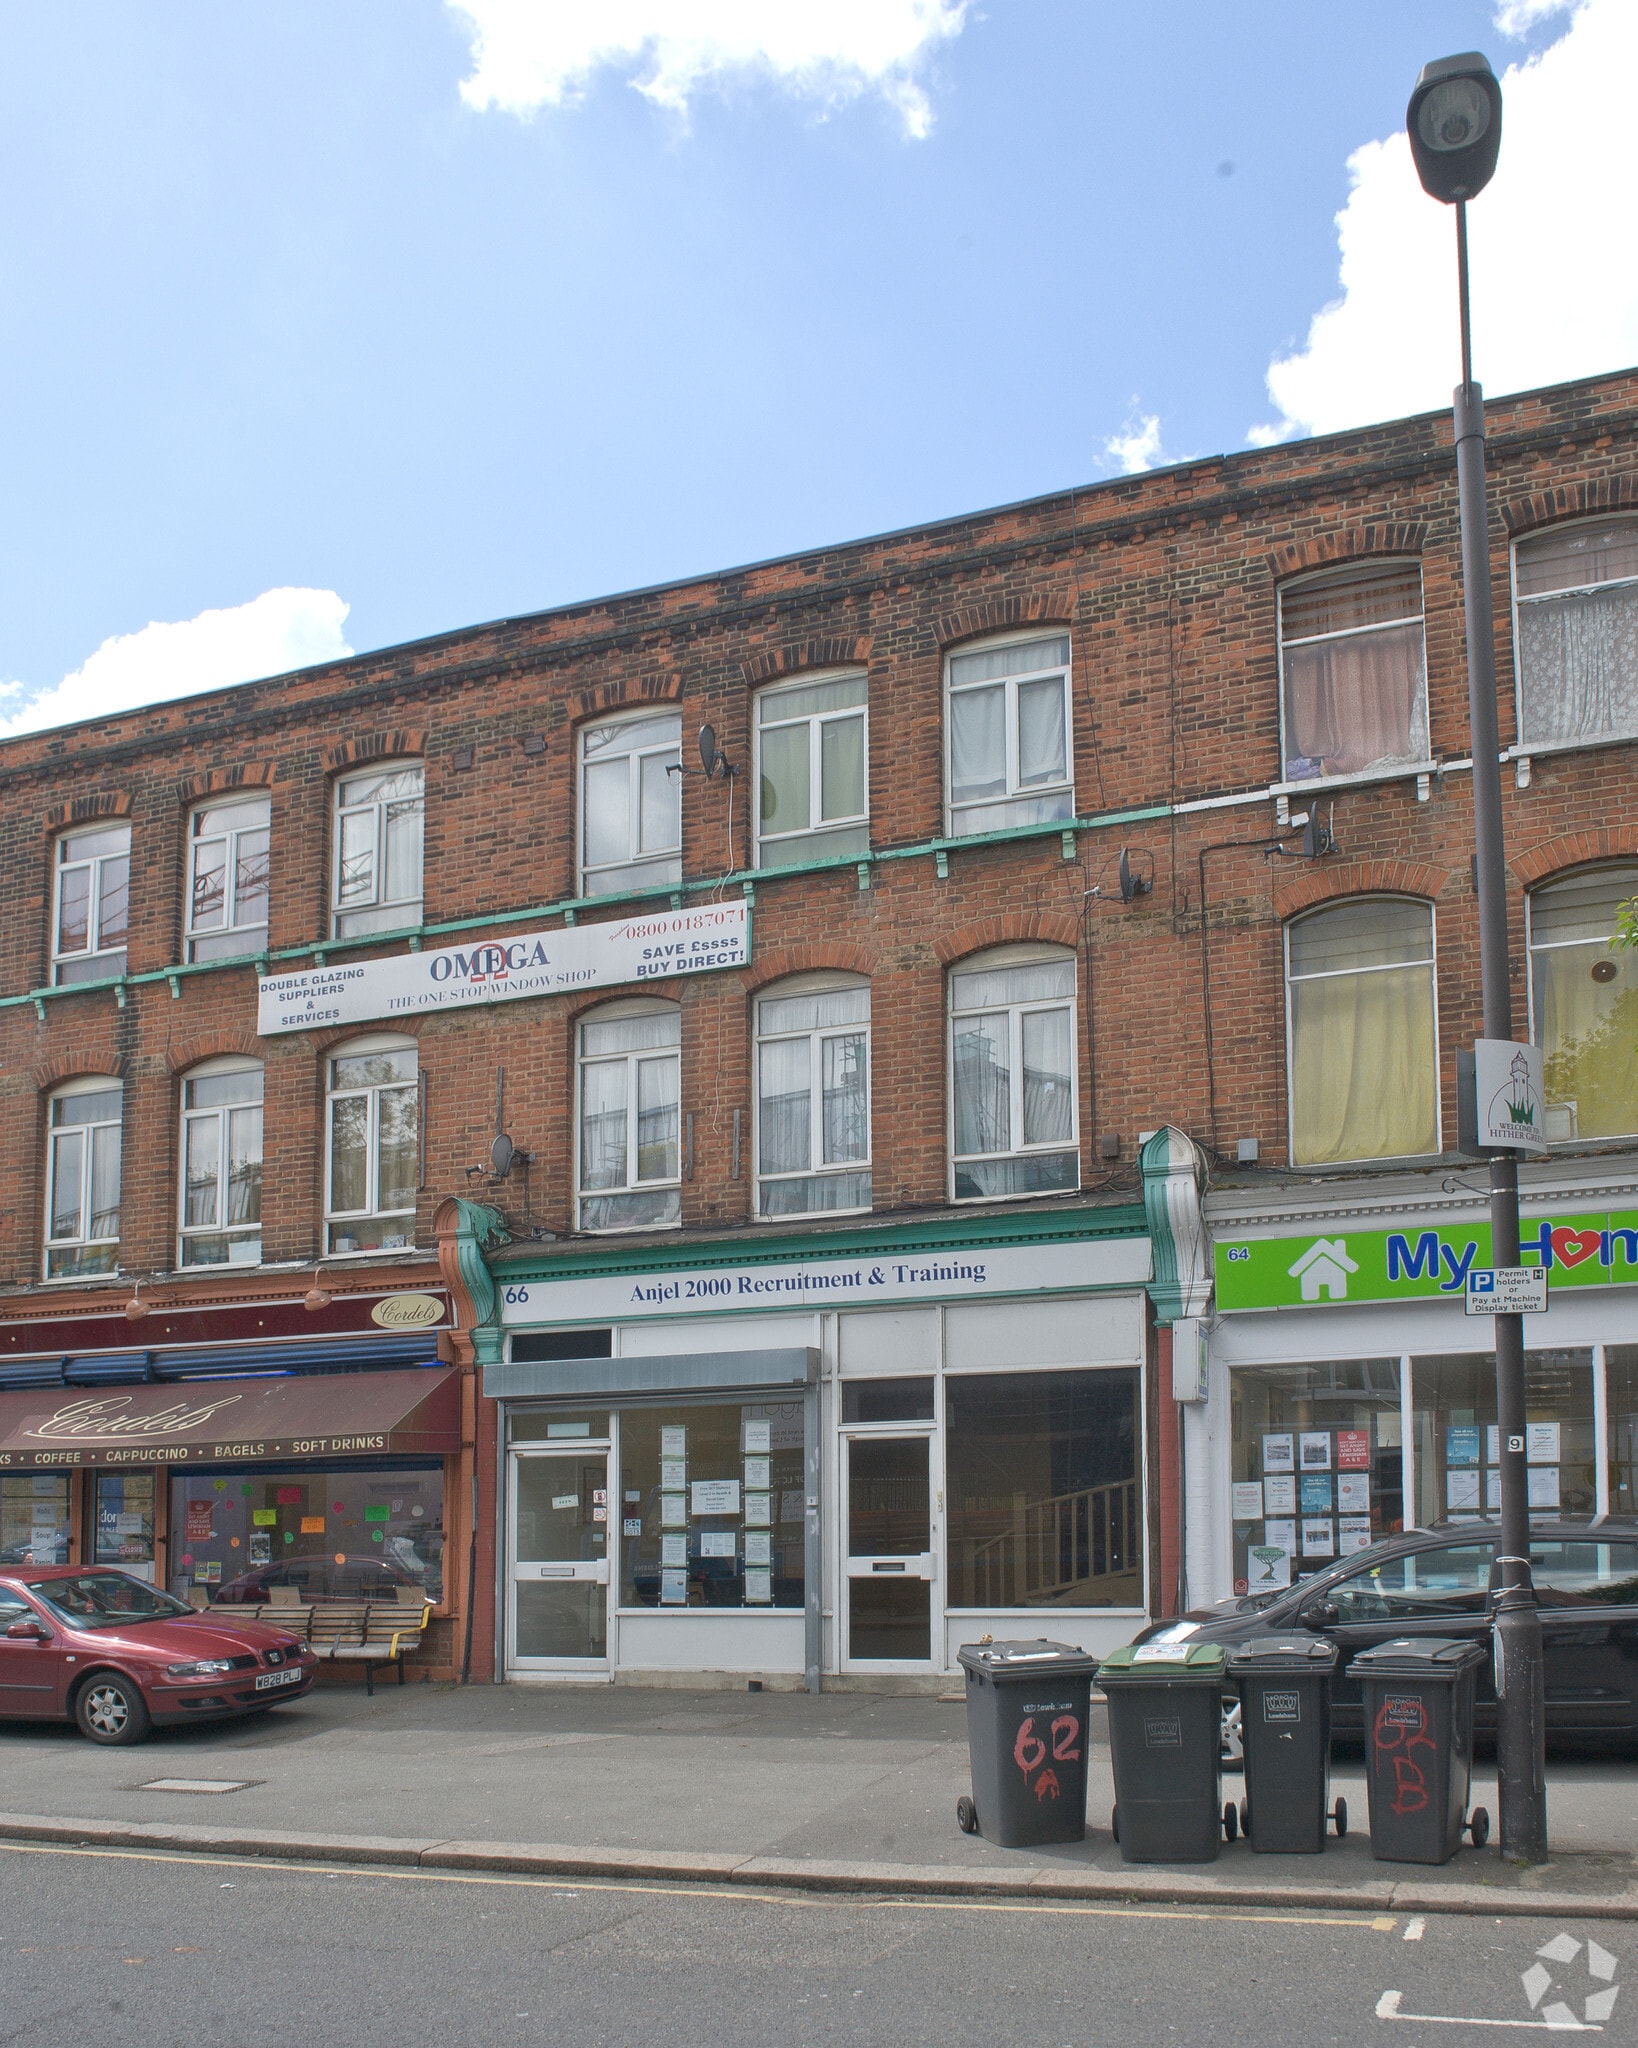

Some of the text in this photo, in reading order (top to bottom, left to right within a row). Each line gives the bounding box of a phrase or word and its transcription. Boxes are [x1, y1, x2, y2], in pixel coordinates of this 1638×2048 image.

[626, 921, 667, 940] 0800
[672, 908, 745, 932] 0187071
[642, 943, 685, 960] SAVE
[430, 940, 551, 982] OMEGA
[637, 950, 744, 977] BUY DIRECT!
[260, 968, 365, 993] DOUBLE GLAZING
[387, 968, 597, 1010] THE ONE STOP WINDOW SHOP
[279, 984, 345, 1002] SUPPLIERS
[306, 1001, 315, 1010] &
[281, 1009, 340, 1026] SERVICES
[1490, 1129, 1525, 1139] HITHER
[1499, 1122, 1532, 1133] WELCOME
[1227, 1246, 1250, 1262] 64
[1386, 1231, 1478, 1291] My
[630, 1261, 986, 1304] Anjel 2000 Recruitment & Training
[1496, 1278, 1531, 1286] holders
[1498, 1270, 1529, 1278] Permit
[505, 1286, 529, 1304] 66
[1472, 1297, 1489, 1305] Pay
[1503, 1295, 1541, 1303] Machine
[1475, 1303, 1538, 1312] Display ticket
[35, 1451, 81, 1464] COFFEE
[106, 1448, 188, 1462] CAPPUCCINO
[214, 1443, 265, 1457] BAGELS
[292, 1439, 328, 1453] SOFT
[331, 1436, 384, 1451] DRINKS
[1510, 1438, 1520, 1450] 9
[35, 1531, 51, 1540] Soup
[257, 1669, 300, 1689] W828 PLJ
[1013, 1714, 1081, 1778] 62
